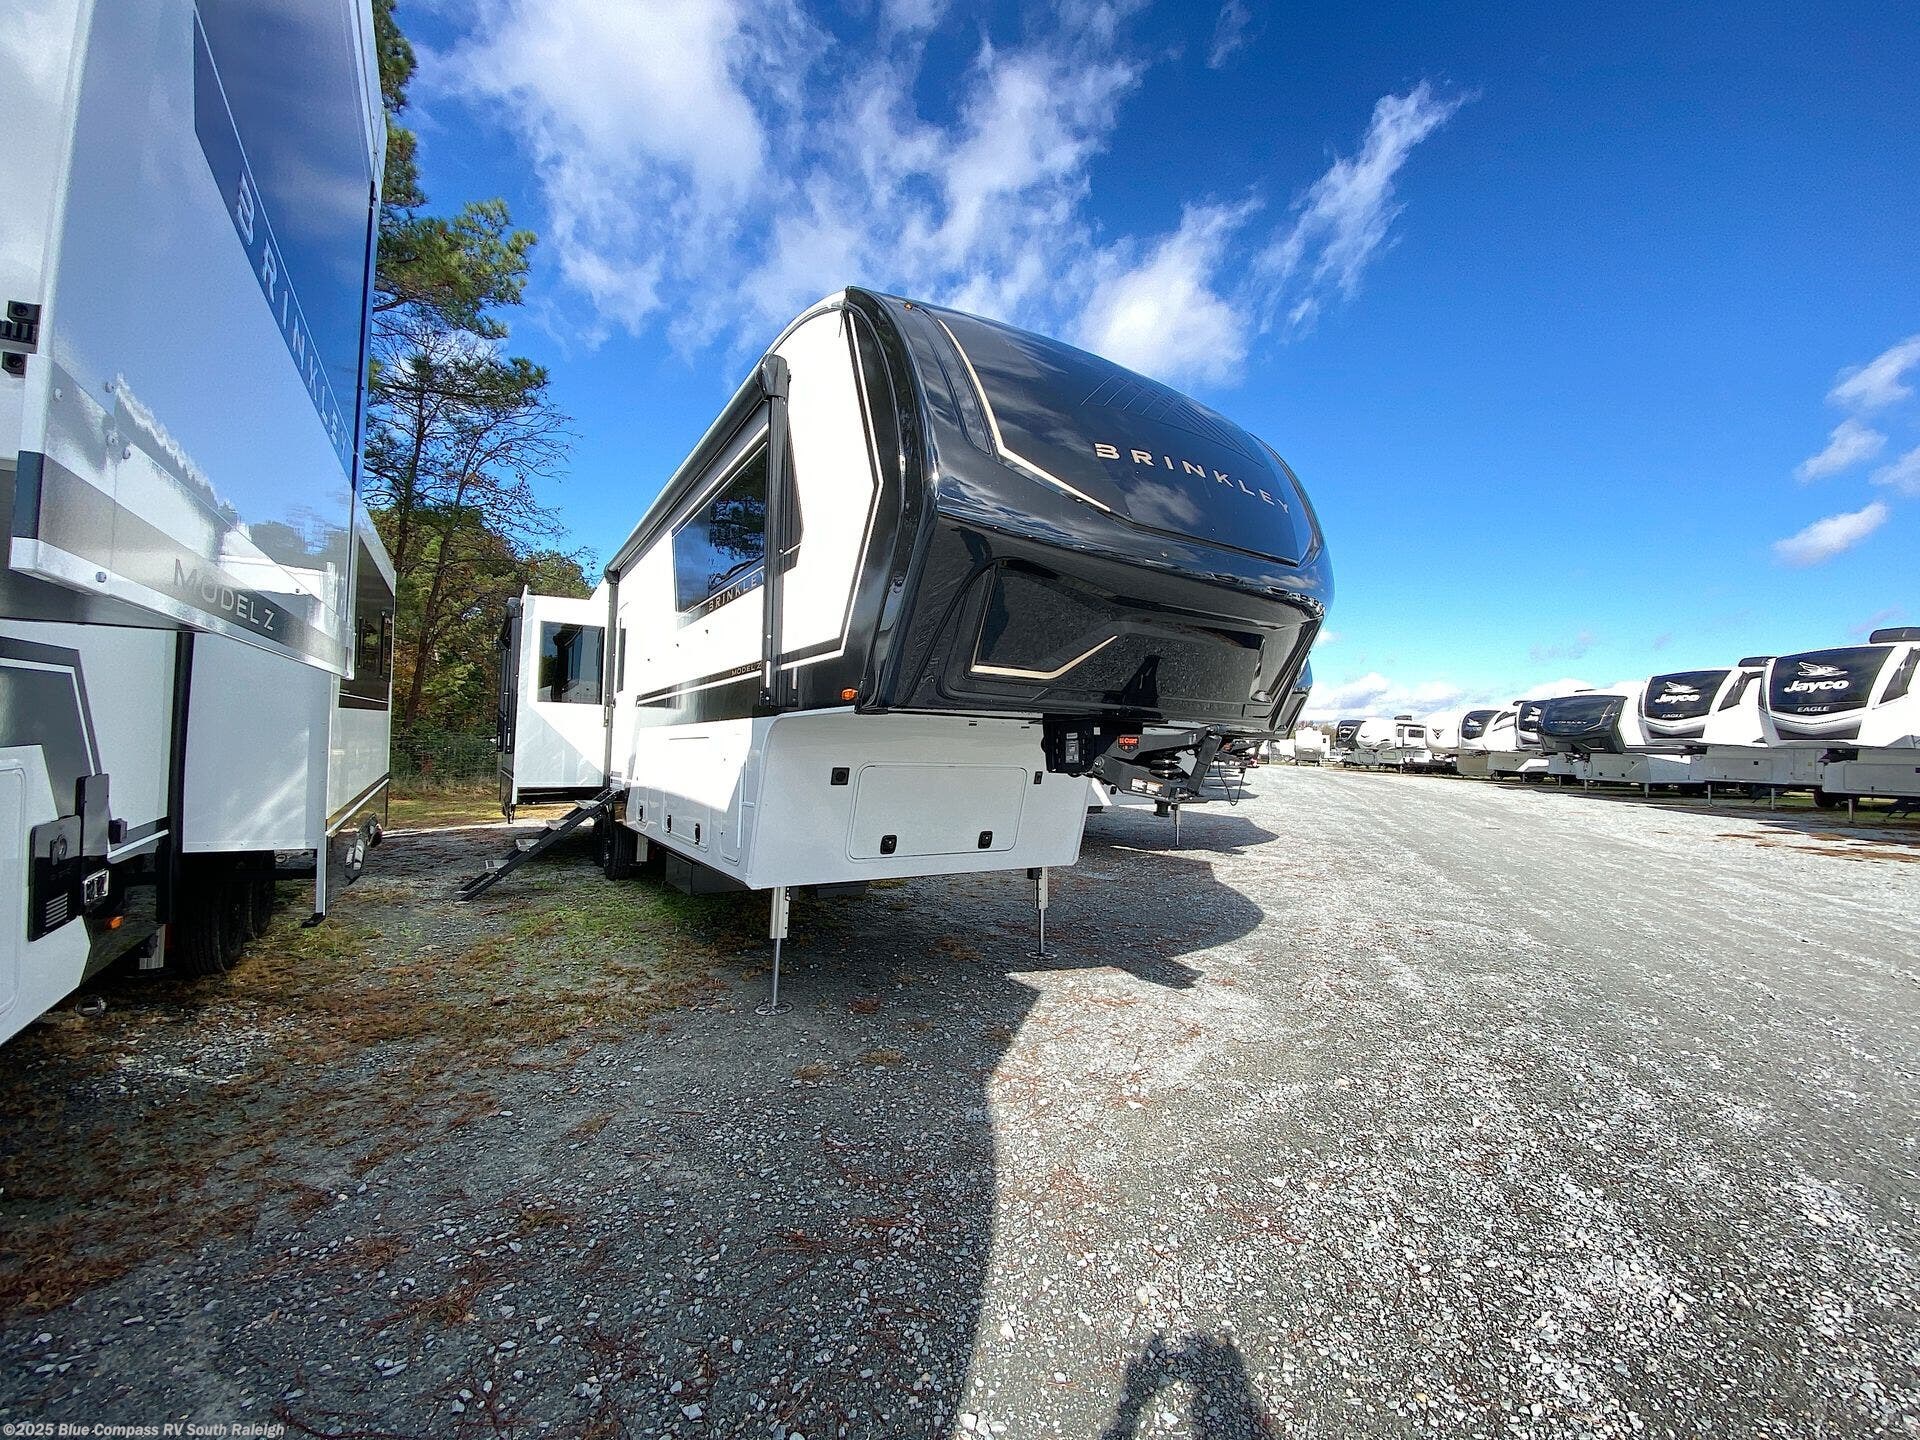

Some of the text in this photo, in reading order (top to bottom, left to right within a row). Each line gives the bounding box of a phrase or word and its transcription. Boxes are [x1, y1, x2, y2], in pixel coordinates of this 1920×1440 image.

[237, 171, 347, 460] BRINKLEY
[1094, 443, 1289, 514] BRINKLEY
[173, 558, 276, 632] MODEL Z
[731, 664, 756, 677] MODEL
[1783, 680, 1850, 693] Jayco
[1654, 693, 1701, 704] Jayco
[1797, 705, 1830, 713] EAGLE
